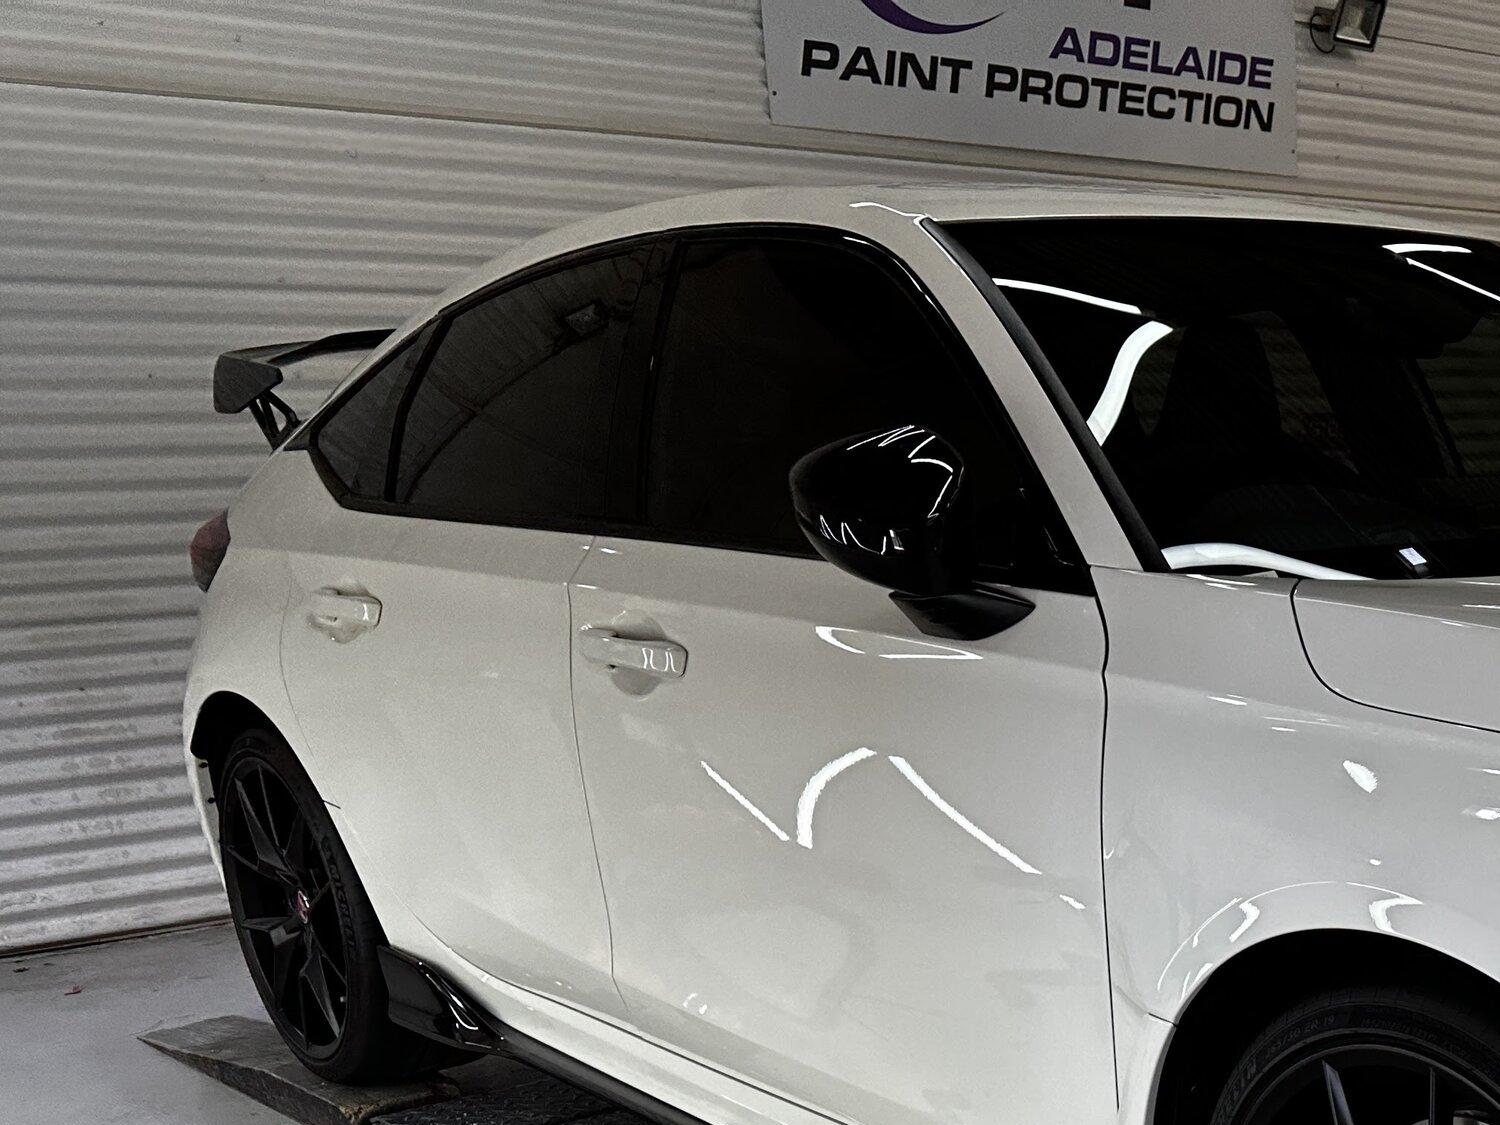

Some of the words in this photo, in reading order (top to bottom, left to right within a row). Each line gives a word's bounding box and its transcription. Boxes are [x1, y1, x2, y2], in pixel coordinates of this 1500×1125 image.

[800, 38, 973, 94] PAINT
[984, 63, 1275, 133] PROTECTION
[1049, 26, 1274, 90] ADELAIDE
